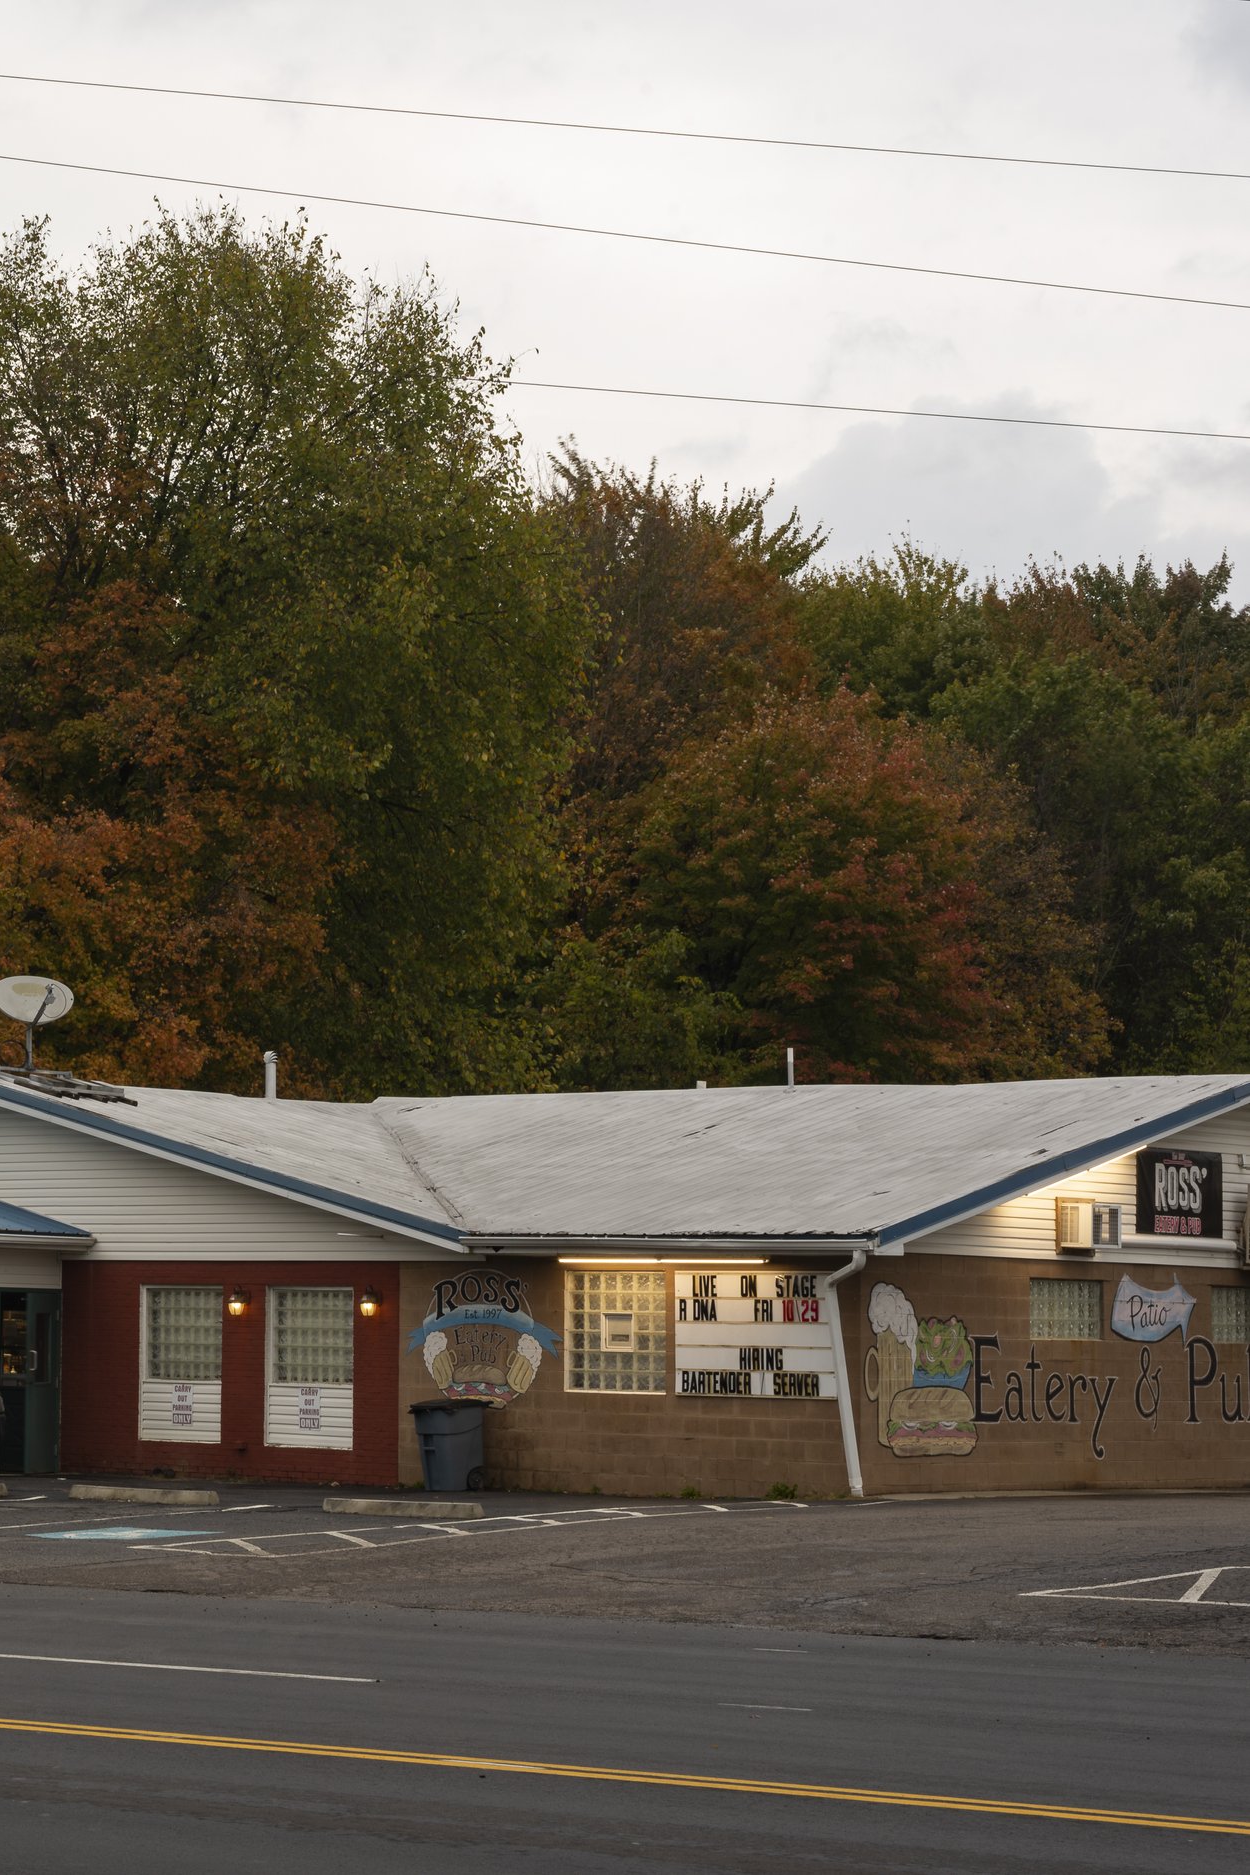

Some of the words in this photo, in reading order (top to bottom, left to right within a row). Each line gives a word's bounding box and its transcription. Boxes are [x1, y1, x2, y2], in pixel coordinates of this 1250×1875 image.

[1155, 1162, 1207, 1214] ROSS'
[1154, 1214, 1179, 1234] EATERY
[1180, 1216, 1188, 1234] &
[1187, 1216, 1202, 1235] PUB
[692, 1275, 717, 1297] LIVE
[740, 1275, 757, 1297] ON
[775, 1275, 817, 1297] STAGE
[433, 1275, 528, 1320] ROSS'
[483, 1308, 502, 1319] 1997
[679, 1299, 687, 1321] R
[693, 1299, 717, 1321] DNA
[754, 1299, 773, 1322] FRI
[1127, 1294, 1172, 1331] Patio
[454, 1326, 507, 1352] Eatery
[470, 1344, 496, 1363] Pub
[739, 1348, 783, 1370] HIRING
[175, 1384, 191, 1392] CARRY
[301, 1388, 318, 1396] CARRY
[682, 1371, 751, 1394] BARTENDER
[773, 1373, 820, 1396] SERVER
[969, 1331, 1119, 1460] Eatery
[1134, 1345, 1163, 1432] &
[1184, 1335, 1250, 1425] Pu
[173, 1414, 191, 1423] ONLY
[300, 1418, 319, 1428] ONLY
